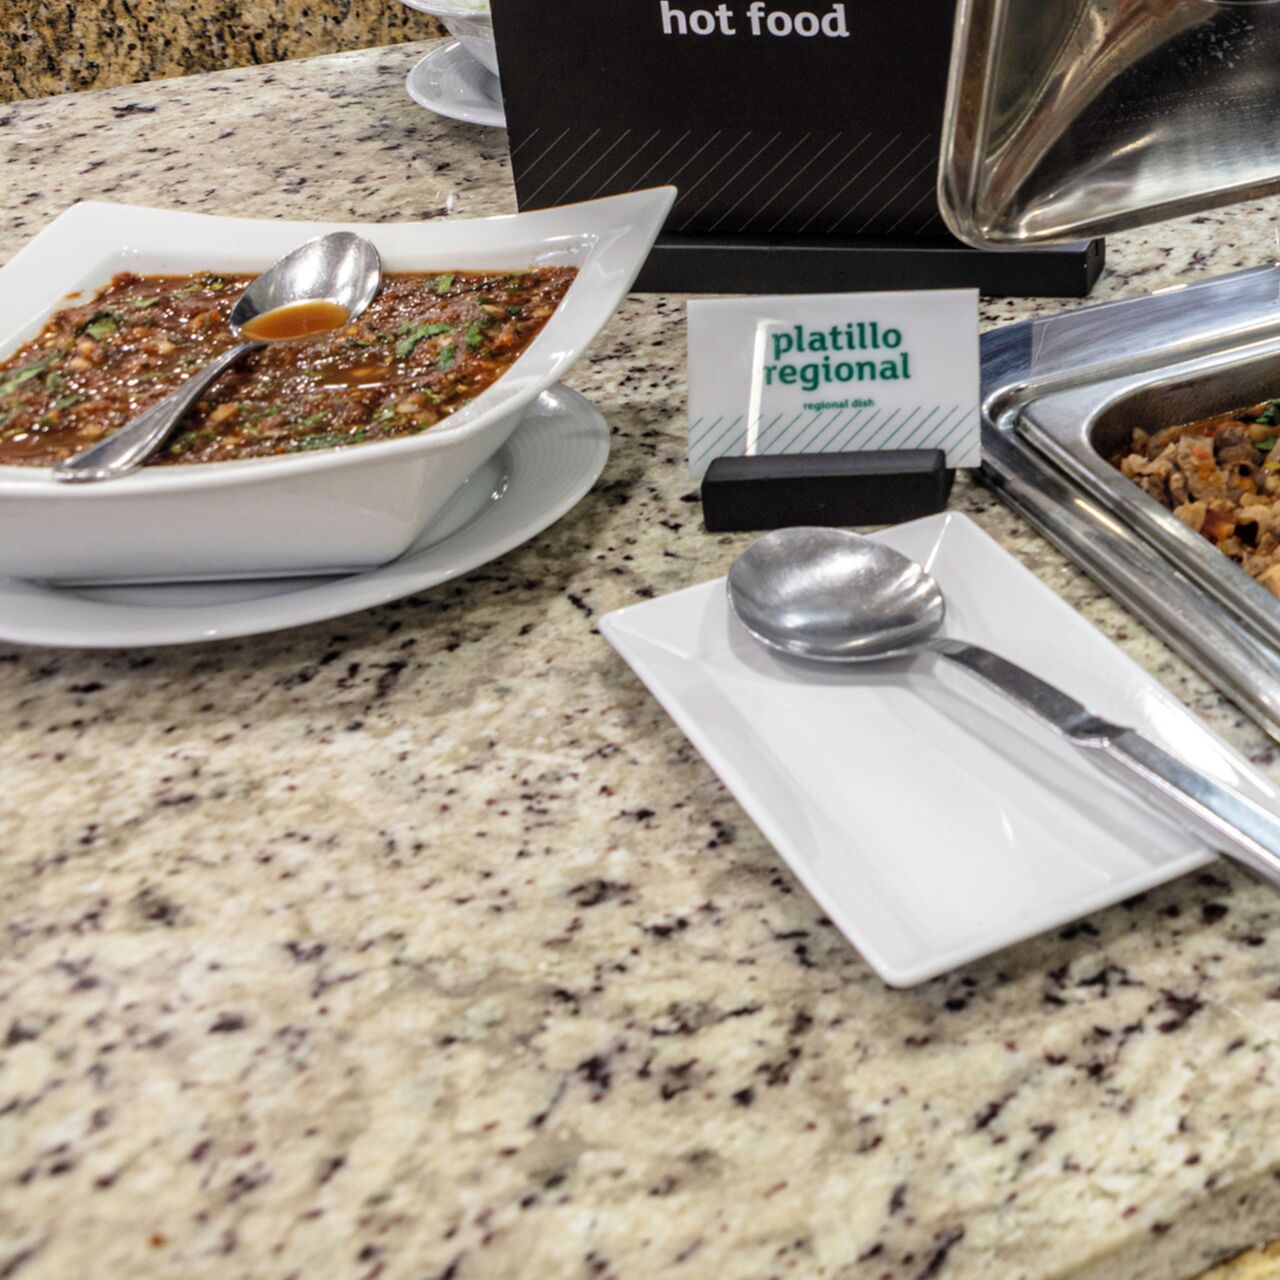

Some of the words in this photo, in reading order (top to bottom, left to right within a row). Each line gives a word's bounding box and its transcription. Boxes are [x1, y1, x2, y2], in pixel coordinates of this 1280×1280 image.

[660, 0, 736, 36] hot
[746, 1, 850, 38] food
[771, 322, 901, 360] platillo
[763, 352, 911, 391] regional
[803, 399, 849, 412] regional
[852, 399, 875, 408] dish
